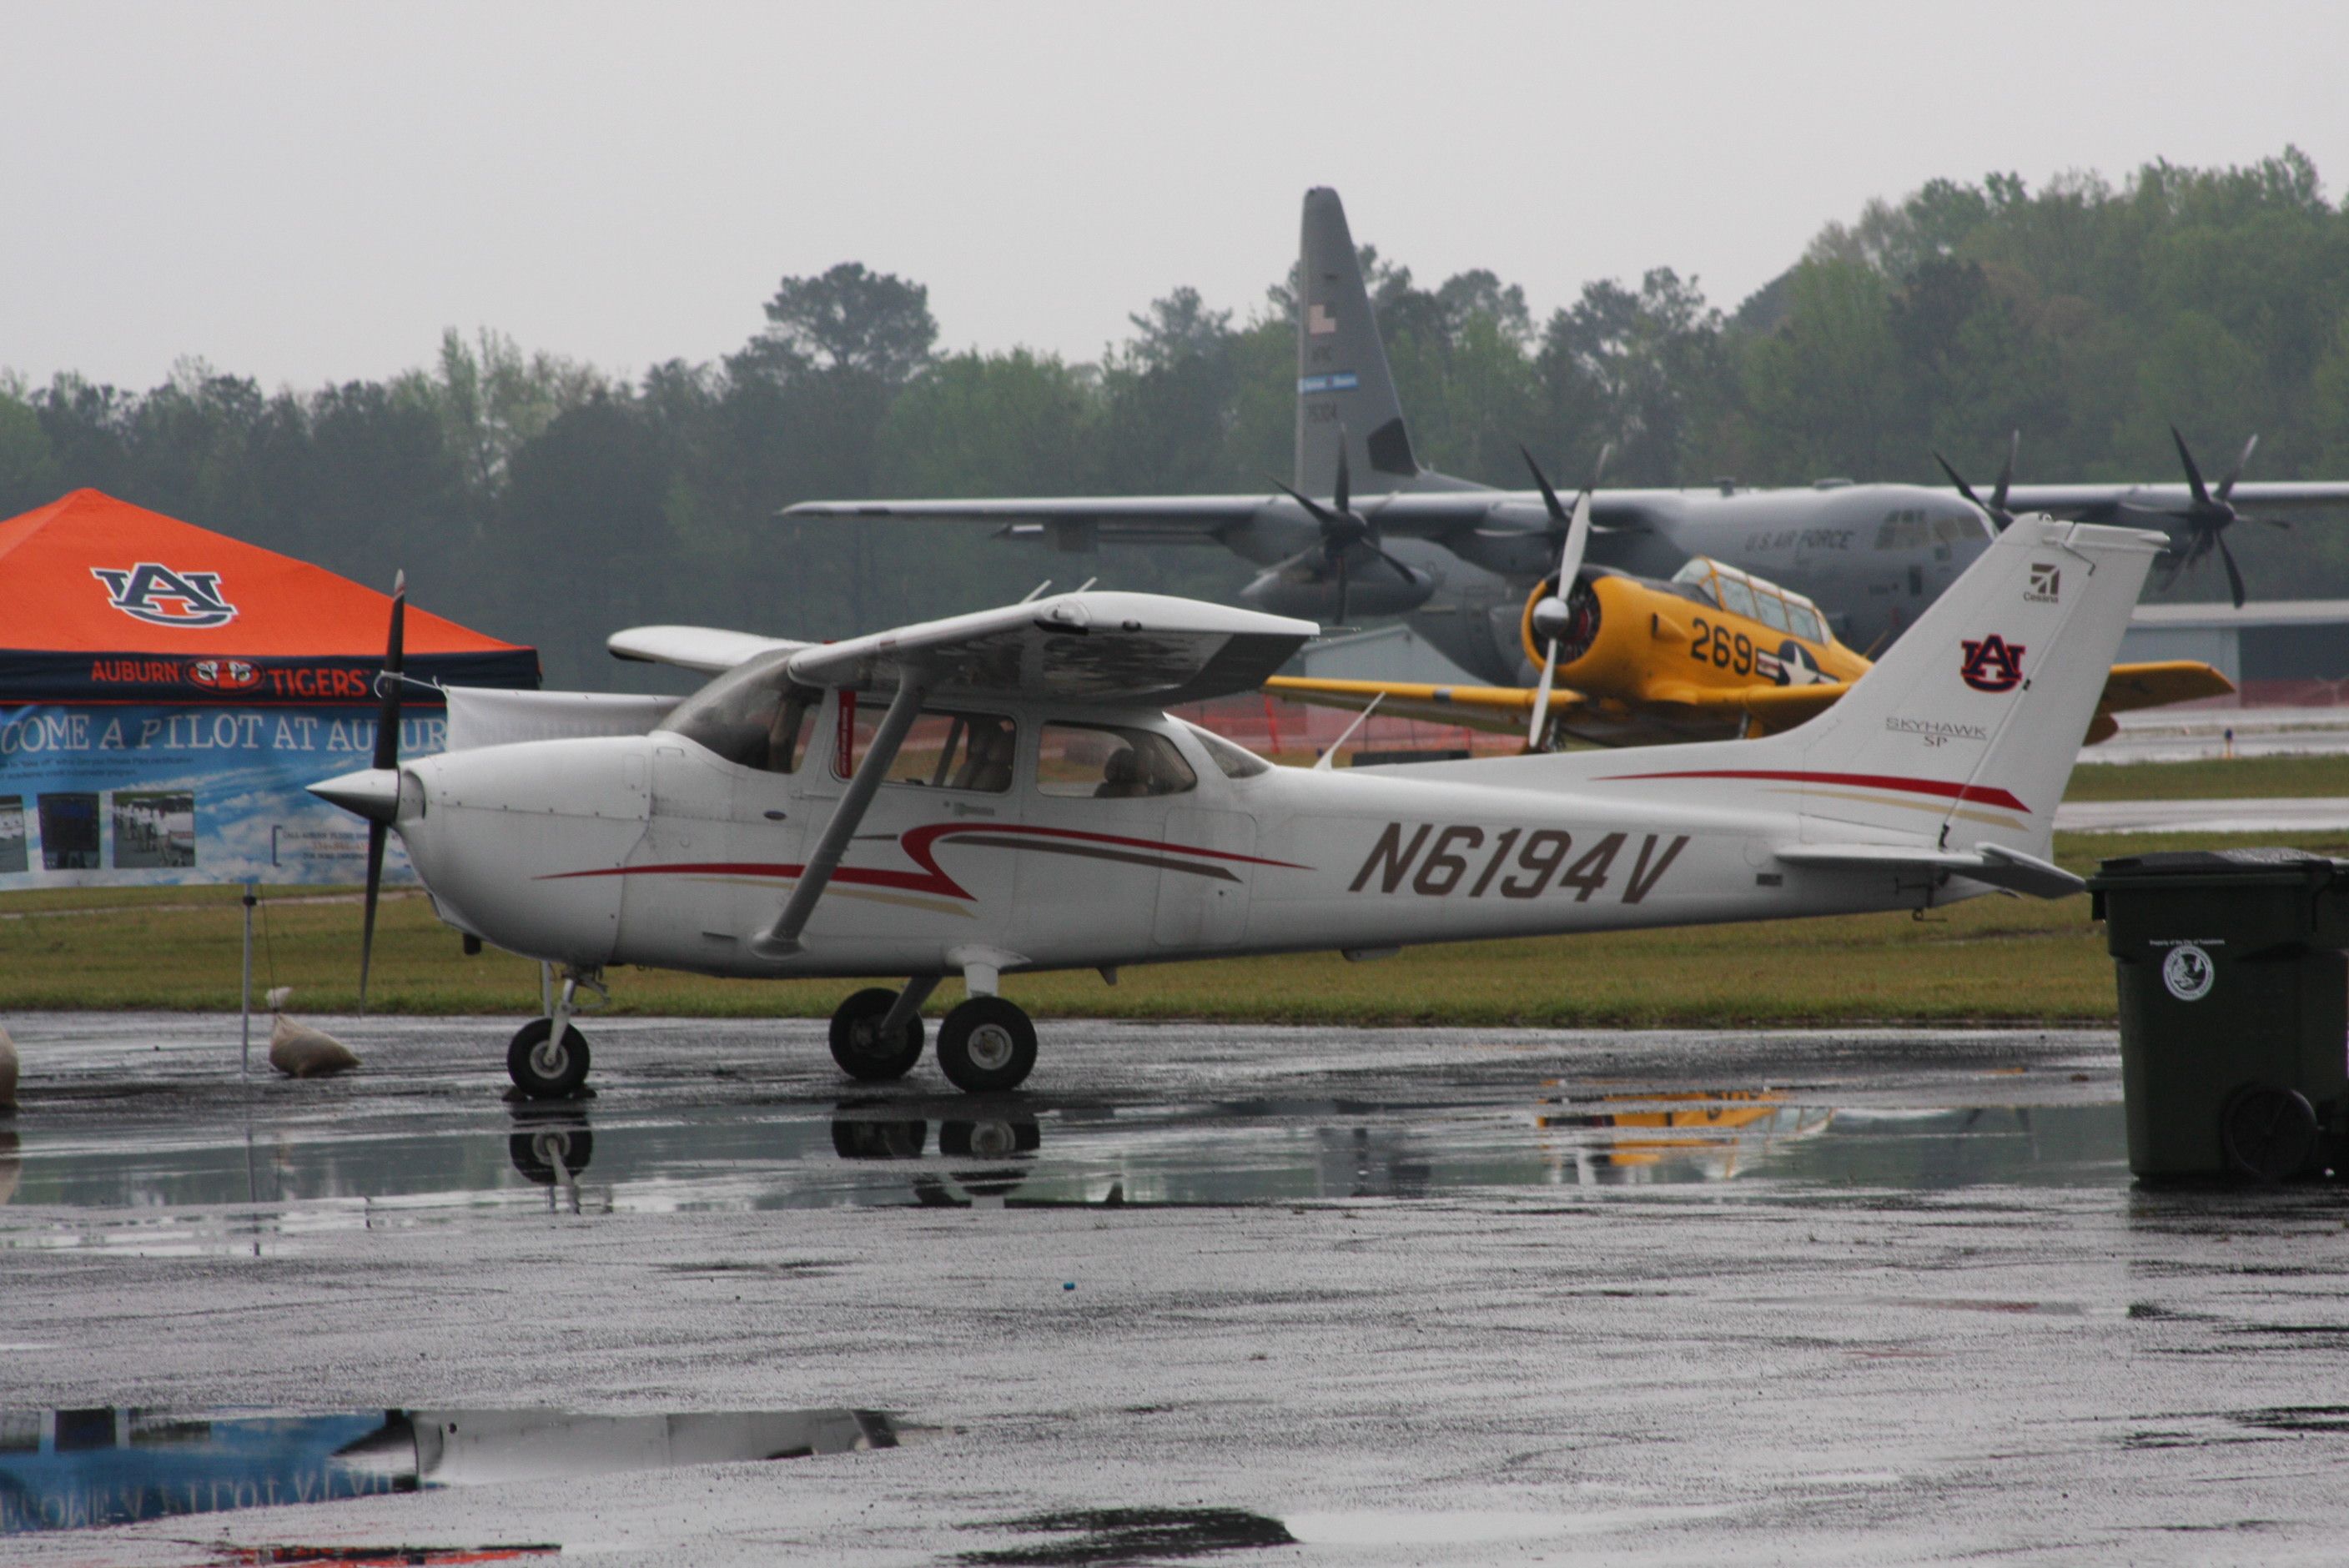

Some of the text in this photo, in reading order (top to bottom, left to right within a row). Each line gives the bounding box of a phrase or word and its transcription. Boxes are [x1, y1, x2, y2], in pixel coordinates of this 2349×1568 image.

[1773, 530, 1798, 548] AIR
[1798, 529, 1856, 550] FORCE
[2024, 591, 2059, 603] Cessna
[1691, 616, 1753, 676] 269
[91, 661, 366, 696] AUBURN TIGERS
[2, 714, 90, 754] COME
[98, 717, 125, 750] A
[135, 714, 263, 750] PILOT
[272, 716, 318, 750] AT
[1886, 717, 1987, 738] SKYHAWK
[1924, 736, 1948, 747] SP
[1347, 822, 1691, 904] N6194V
